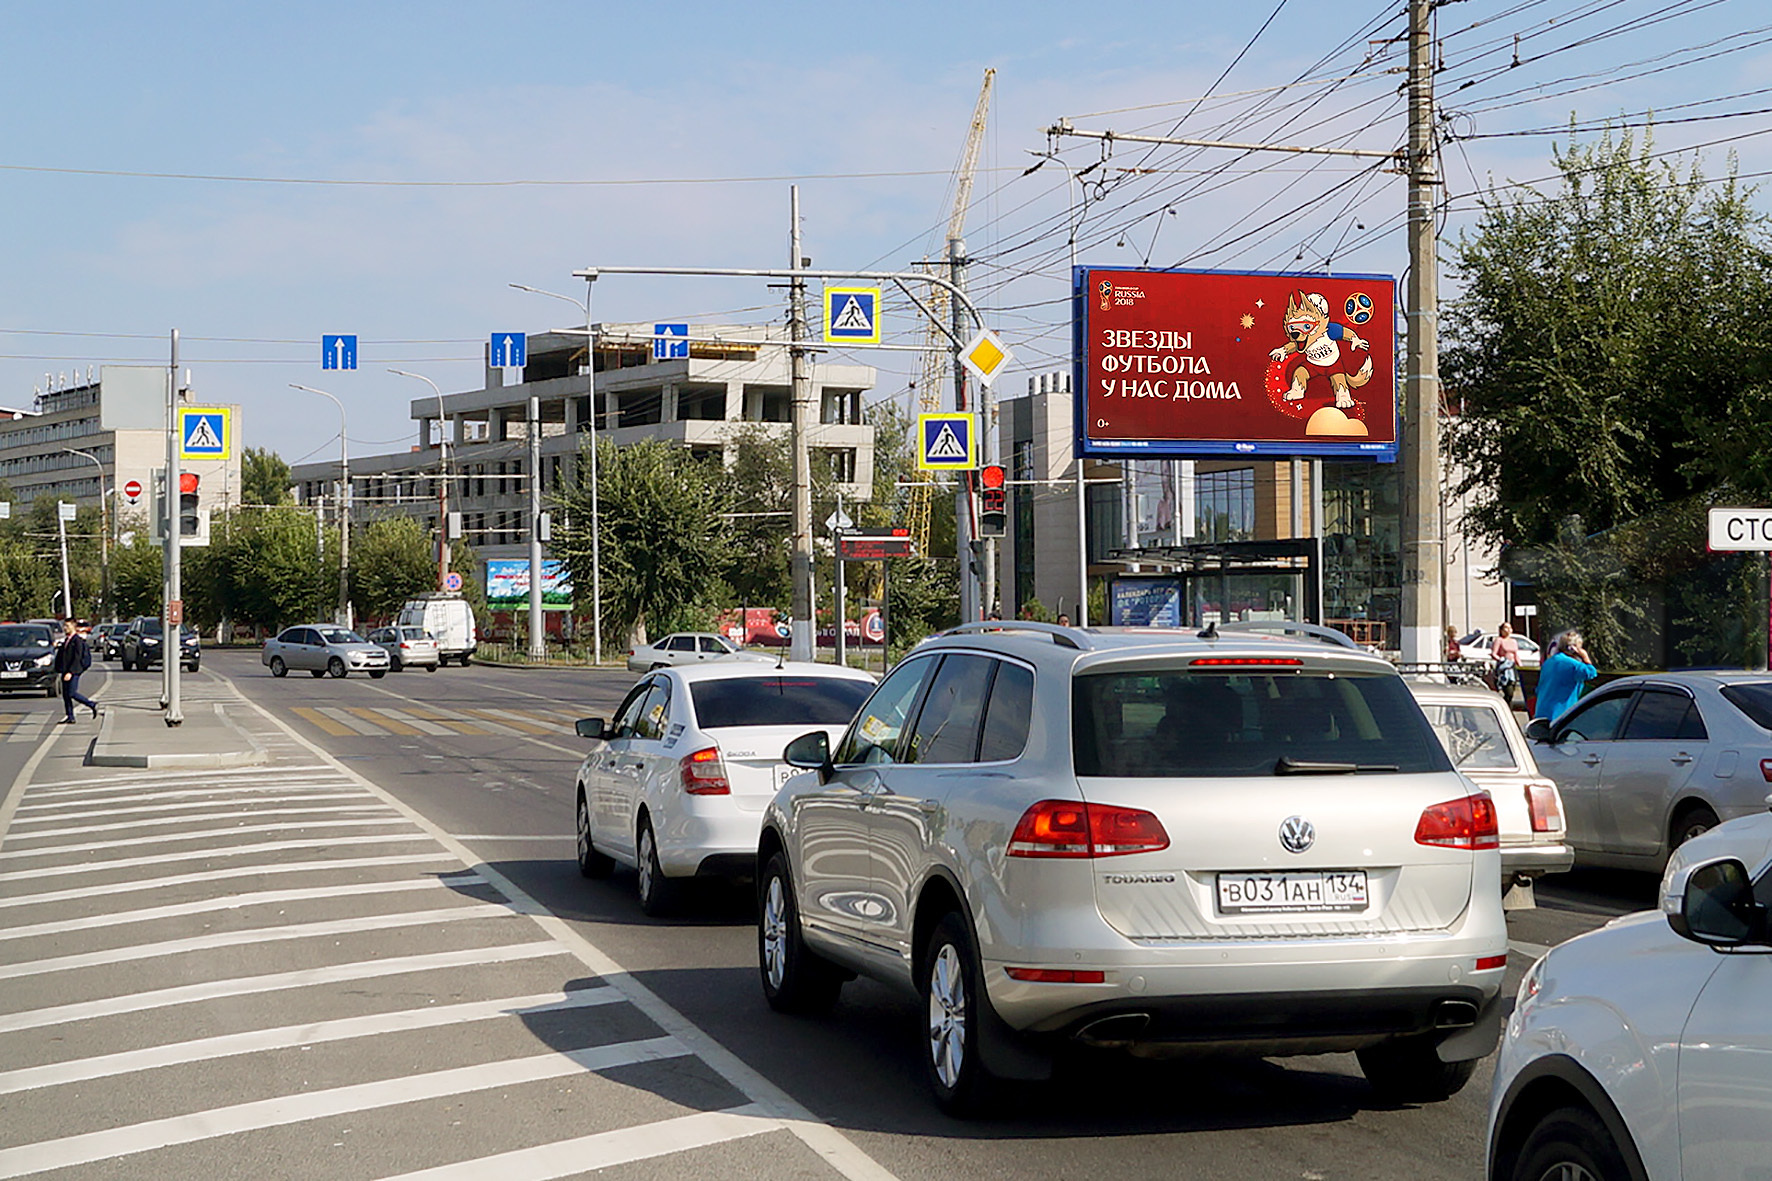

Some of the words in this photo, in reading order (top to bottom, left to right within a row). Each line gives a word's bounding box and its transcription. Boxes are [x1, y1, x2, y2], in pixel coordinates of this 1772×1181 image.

[1114, 290, 1146, 298] RUSSIA
[1114, 298, 1135, 306] 2018
[1101, 329, 1192, 352] ЗВЕЗДЫ
[1101, 354, 1211, 374] ФУТБОЛА
[1101, 379, 1116, 398] У
[1121, 379, 1169, 398] НАС
[1172, 380, 1242, 402] ДОМА
[1097, 418, 1110, 428] 0+
[985, 490, 1004, 510] 22
[1228, 876, 1321, 902] В031АН
[1325, 874, 1360, 893] 134
[1334, 893, 1353, 902] RUS
